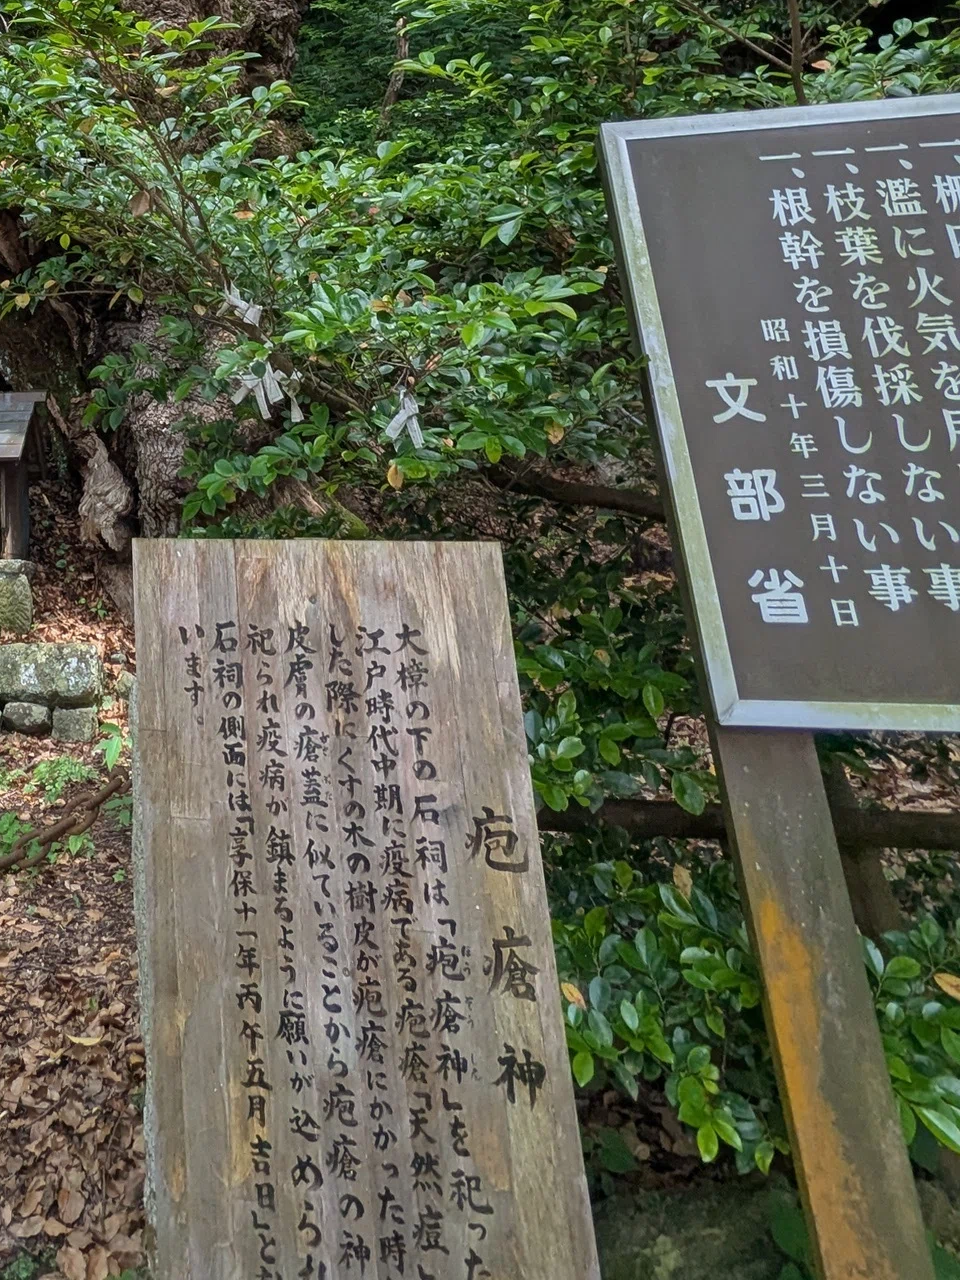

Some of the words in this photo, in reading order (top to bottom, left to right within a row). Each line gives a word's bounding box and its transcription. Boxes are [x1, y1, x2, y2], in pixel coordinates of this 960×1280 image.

[759, 152, 918, 611] 一、根幹を損傷しない事
[811, 147, 960, 611] 一、枝葉を伐採しない事
[864, 143, 960, 468] 一、濫に火気を
[705, 372, 808, 623] 文部省
[760, 318, 859, 627] 昭和十年三月十日
[179, 624, 205, 725] います。
[325, 624, 407, 1280] した際にくすの木の樹皮が疱瘡にかかった時
[465, 806, 546, 1111] 疱瘡神
